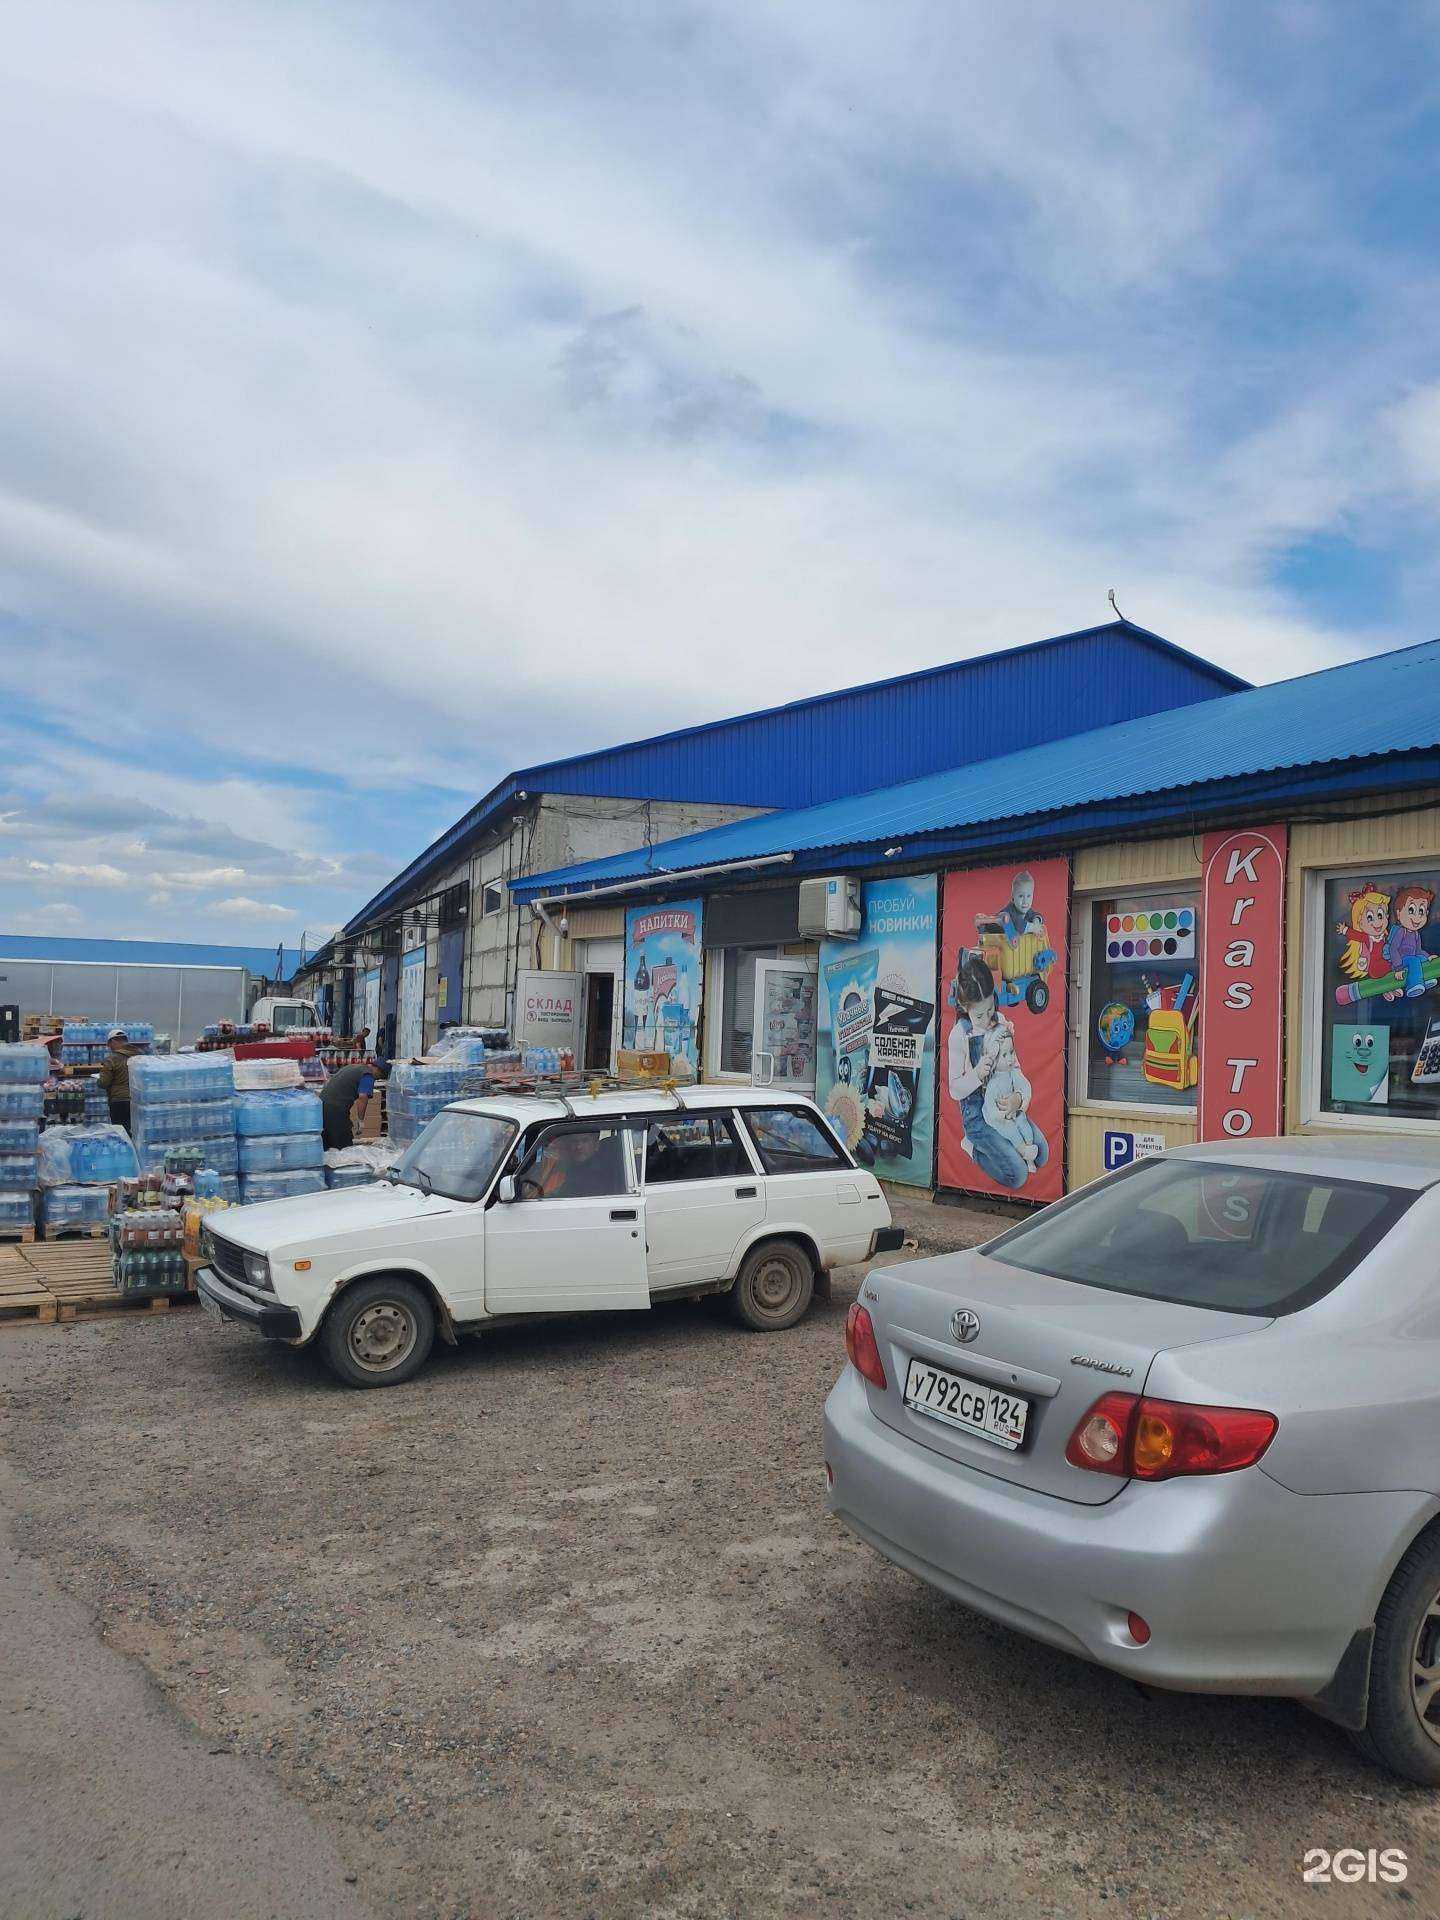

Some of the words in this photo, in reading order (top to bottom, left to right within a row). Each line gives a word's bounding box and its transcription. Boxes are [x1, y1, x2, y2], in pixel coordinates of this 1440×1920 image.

[868, 894, 916, 913] ПРОБУЙ
[639, 914, 689, 934] НАПИТКИ
[869, 914, 933, 934] НОВИНКИ!
[1223, 846, 1264, 1010] Kras
[527, 998, 573, 1013] СКЛАД
[874, 1036, 917, 1050] СОЛЕНАЯ
[993, 1421, 1010, 1435] RUS
